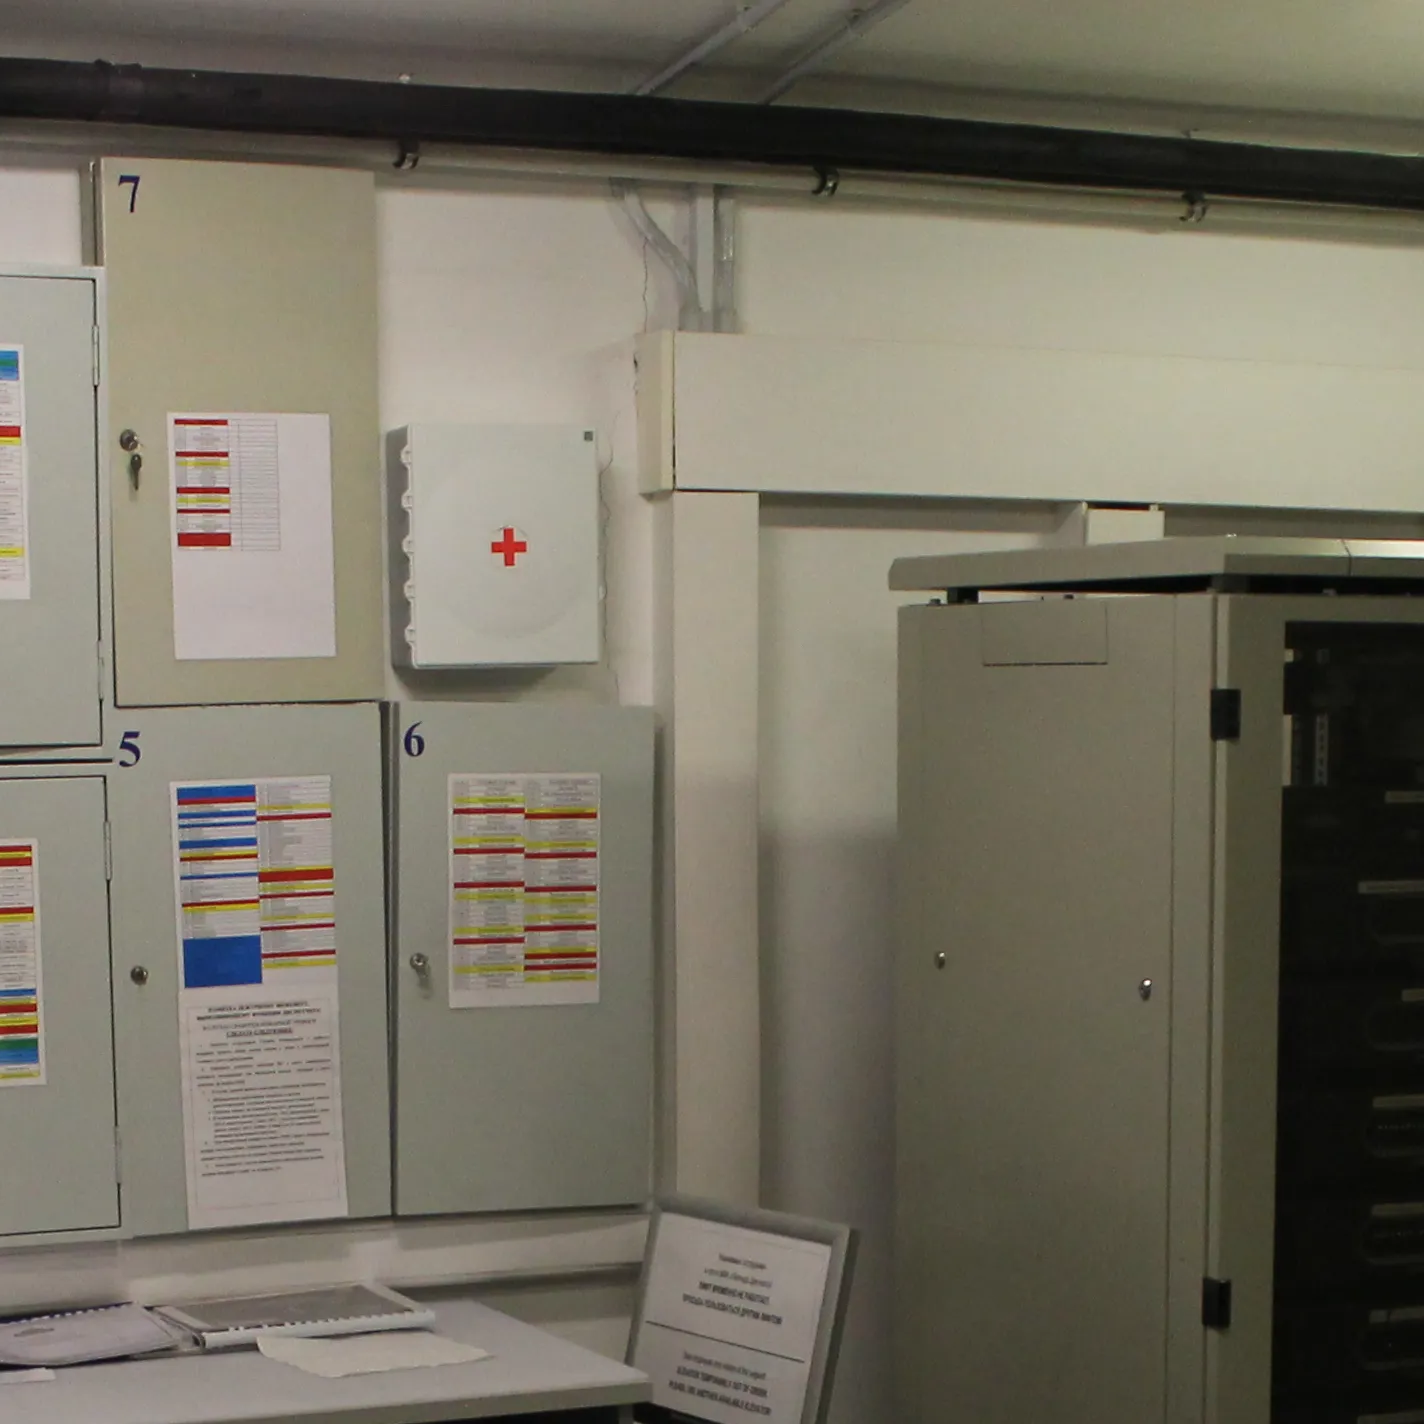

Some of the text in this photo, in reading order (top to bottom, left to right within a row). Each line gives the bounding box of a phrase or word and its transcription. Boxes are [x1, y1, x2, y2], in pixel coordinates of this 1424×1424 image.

[118, 173, 142, 213] 7
[118, 730, 142, 768] 5
[402, 721, 426, 758] 6
